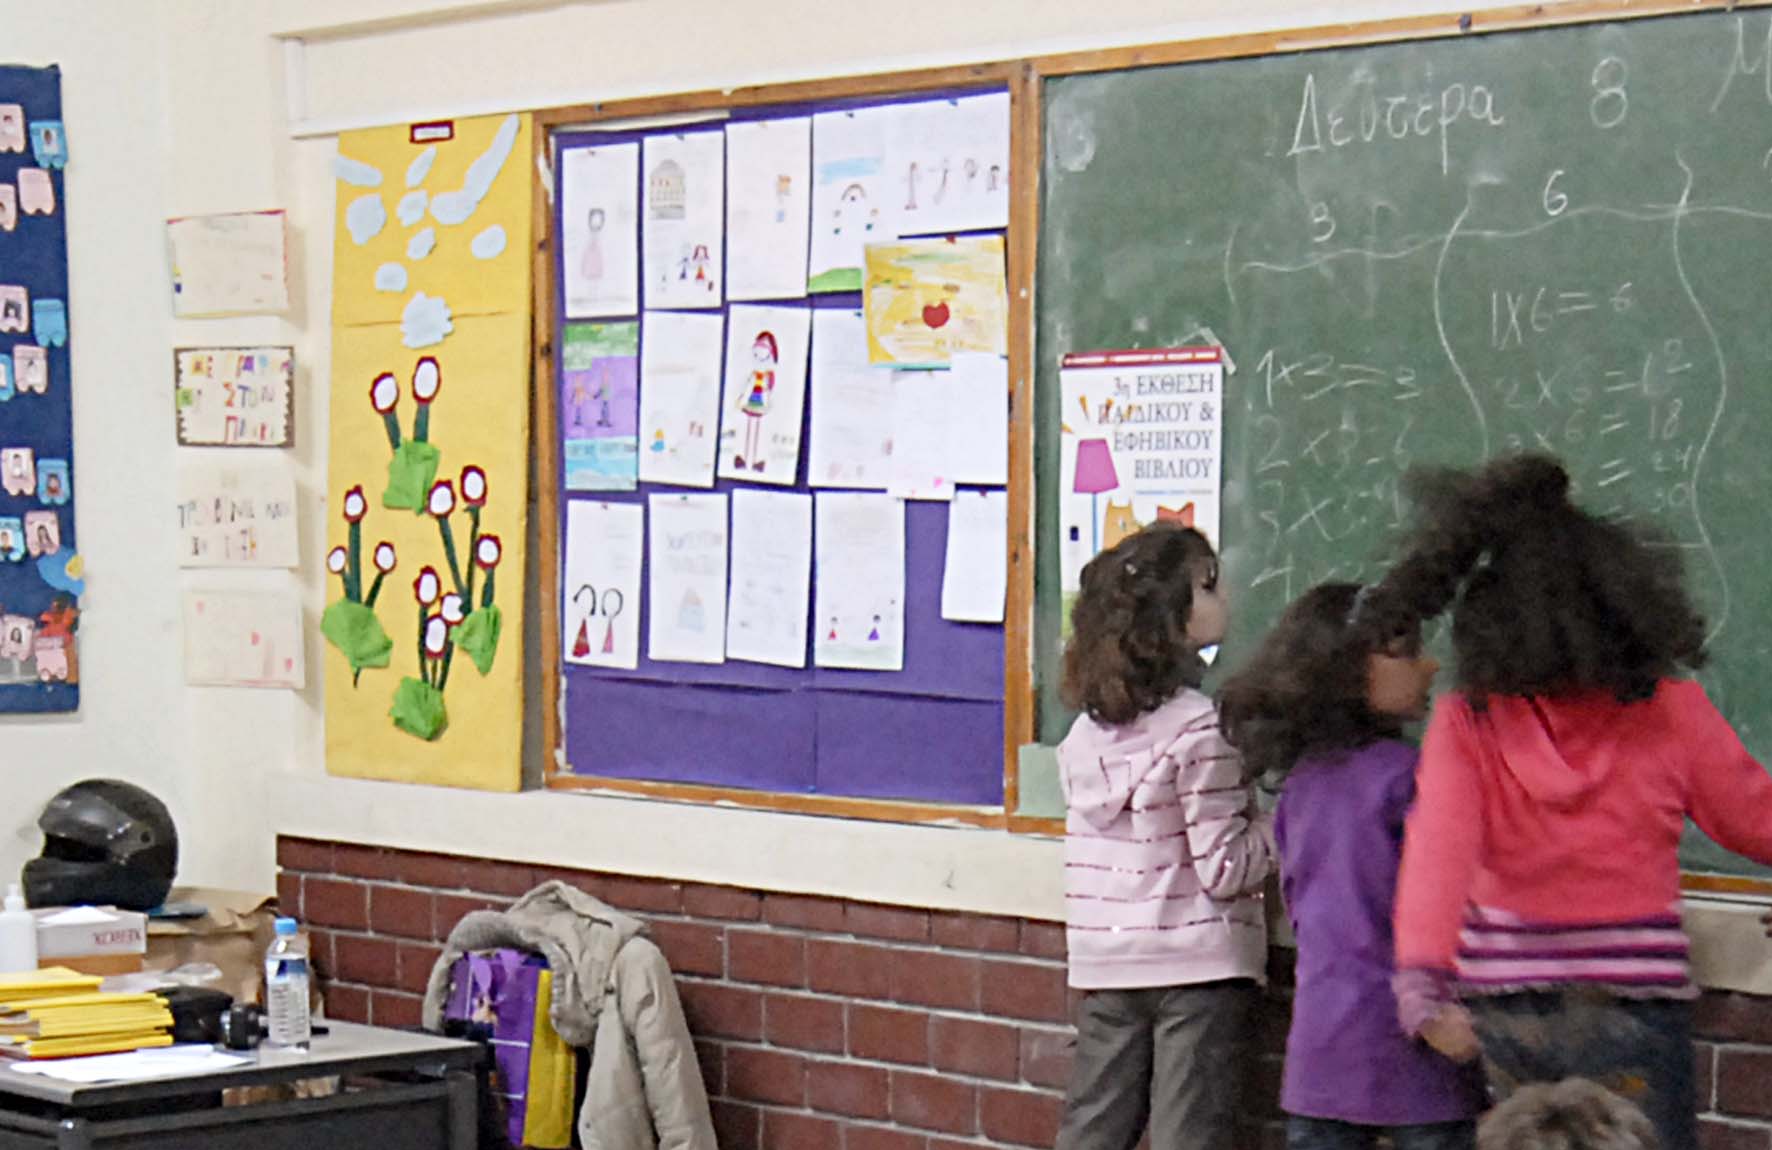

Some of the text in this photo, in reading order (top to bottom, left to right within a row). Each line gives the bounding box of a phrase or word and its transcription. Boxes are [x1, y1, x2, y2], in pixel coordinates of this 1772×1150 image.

[1543, 170, 1569, 216] 6
[1137, 374, 1214, 396] ΕΚΘΕΣΗ
[1114, 430, 1214, 451] ΕΦΗΒΙΚΟΥ
[1135, 458, 1214, 479] ΒΙΒΛΙΟΥ
